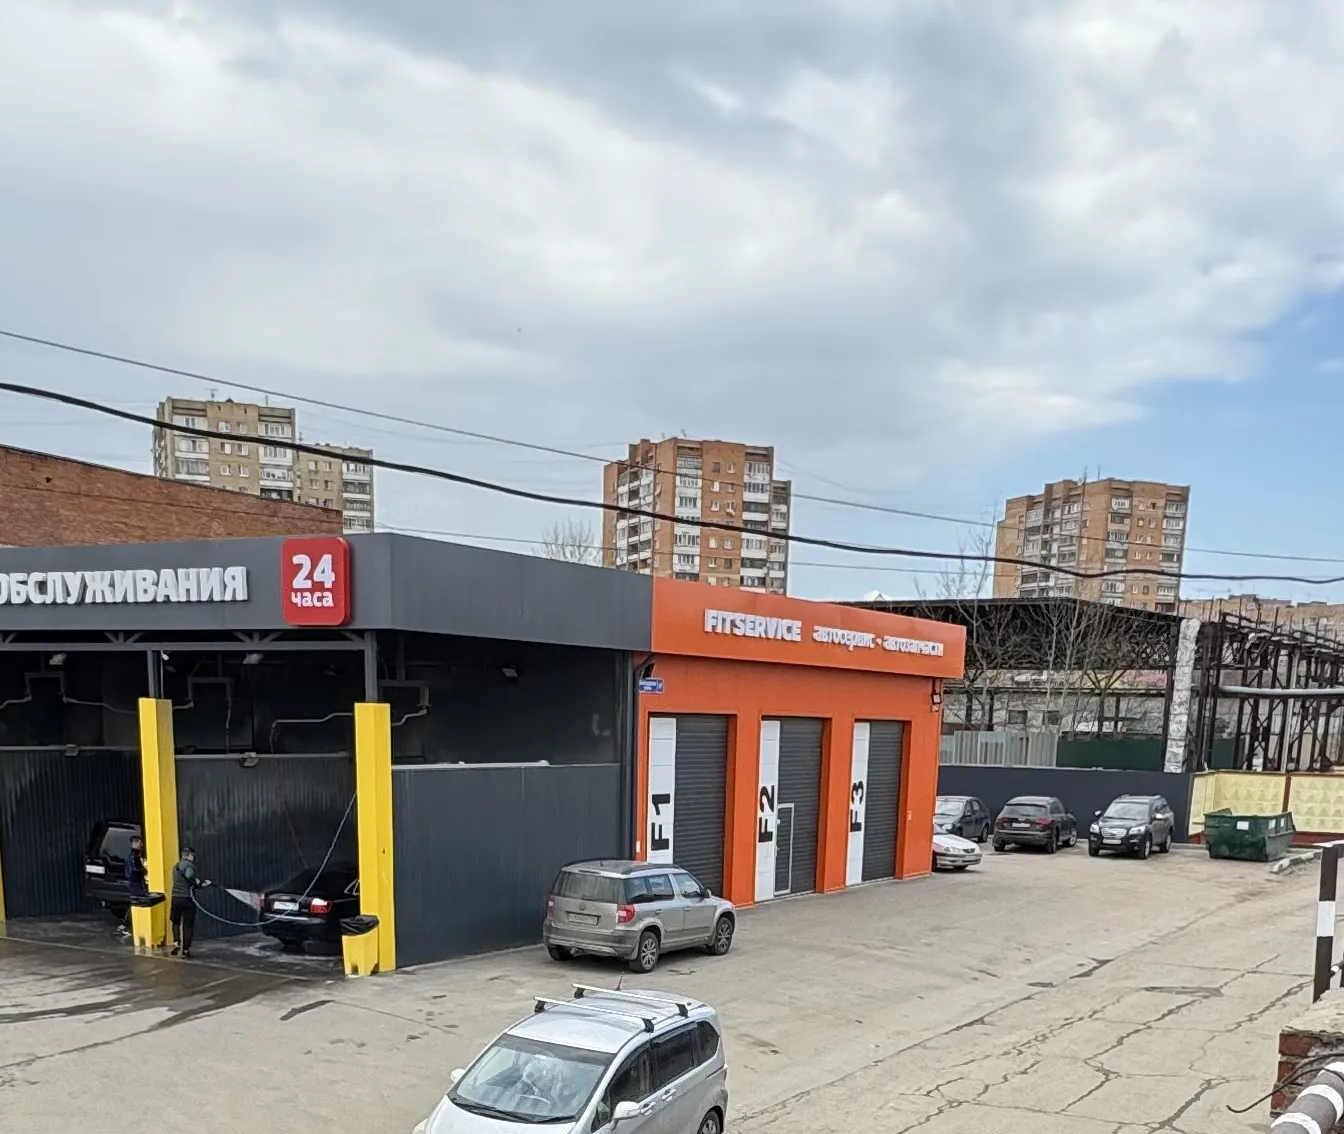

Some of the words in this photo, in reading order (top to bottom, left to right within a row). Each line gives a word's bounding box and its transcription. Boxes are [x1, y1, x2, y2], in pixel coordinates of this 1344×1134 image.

[291, 553, 336, 589] 24
[291, 590, 335, 608] часа
[704, 609, 802, 642] FITSERVICE
[650, 793, 671, 851] F1
[758, 784, 775, 843] F2
[849, 780, 864, 833] F3
